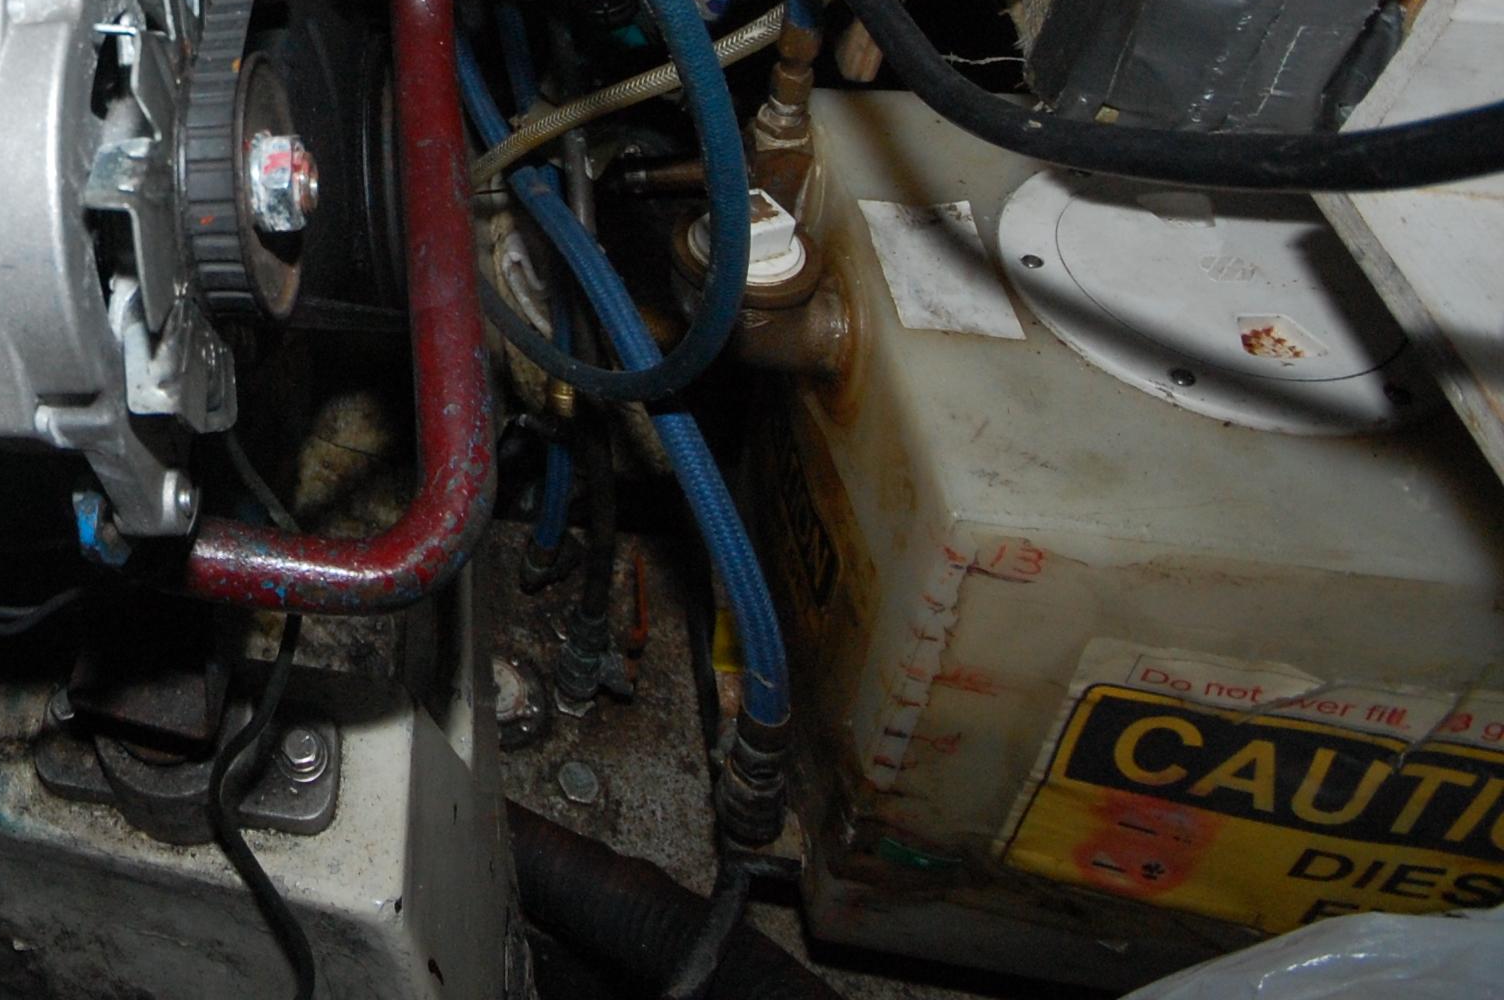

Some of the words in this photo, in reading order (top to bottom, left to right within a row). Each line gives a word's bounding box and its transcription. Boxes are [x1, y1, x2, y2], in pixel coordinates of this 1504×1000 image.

[1139, 667, 1192, 693] Do
[1204, 679, 1264, 702] not
[1275, 695, 1354, 719] ver
